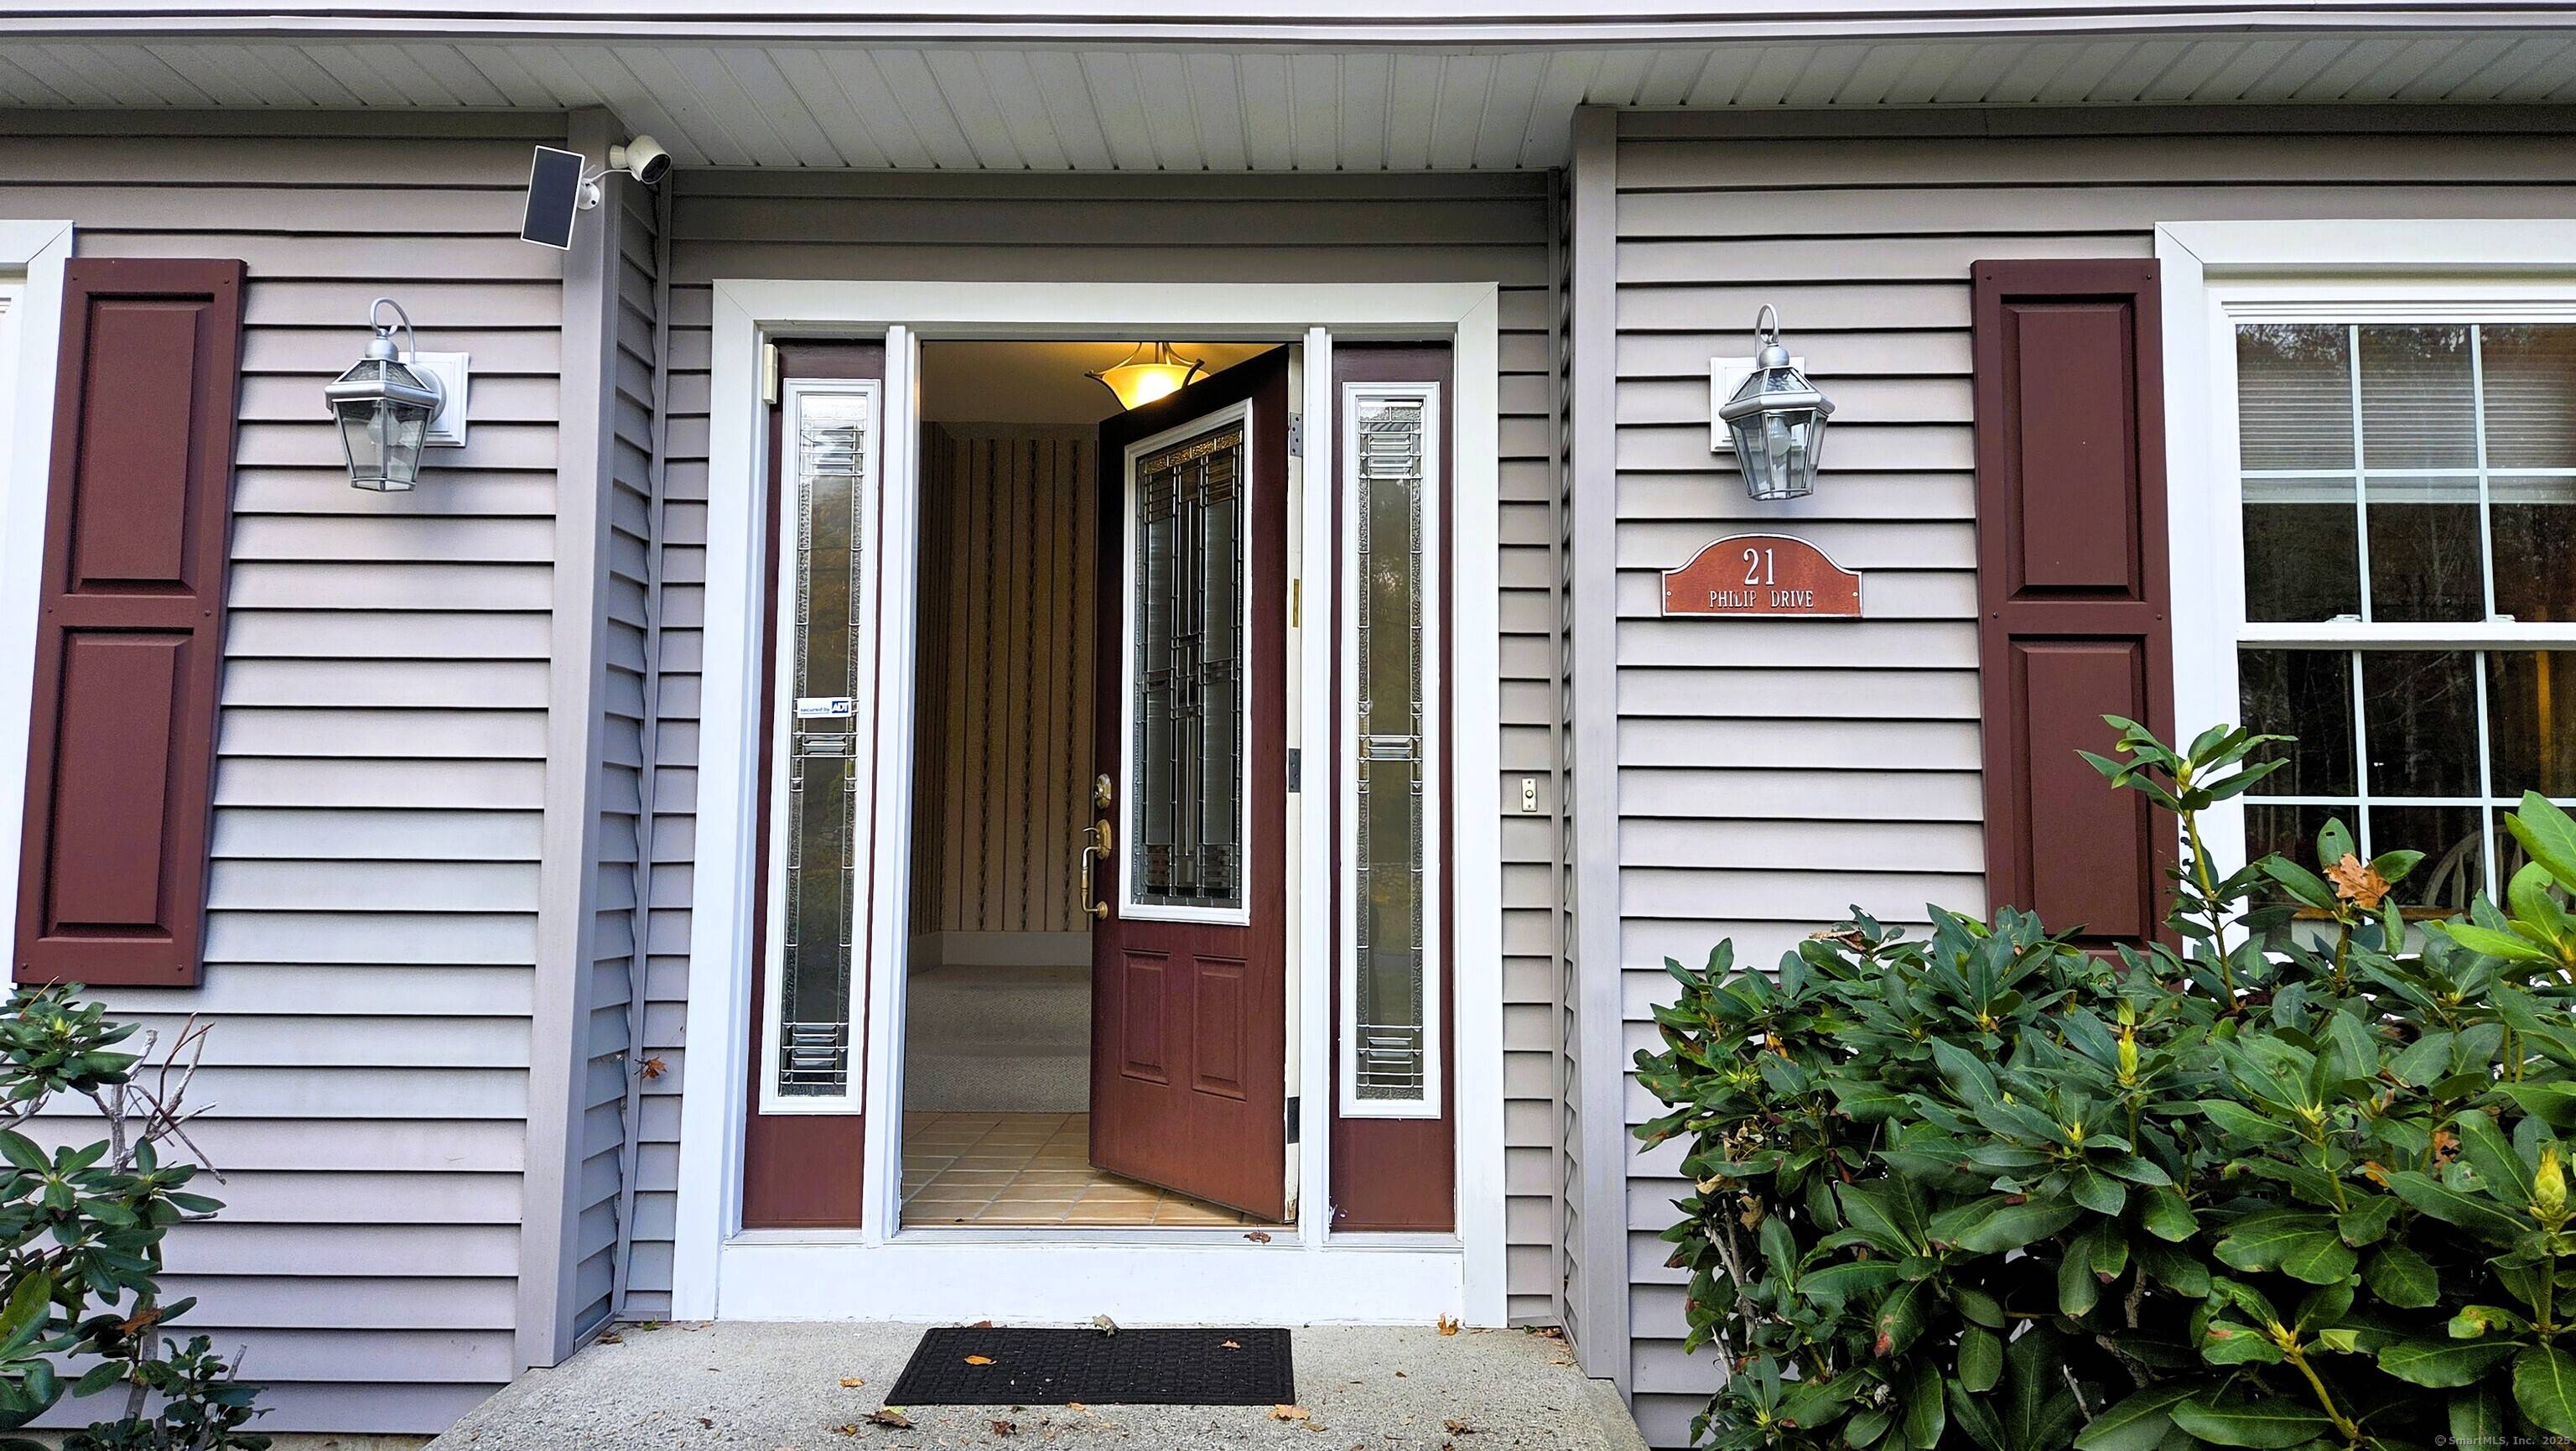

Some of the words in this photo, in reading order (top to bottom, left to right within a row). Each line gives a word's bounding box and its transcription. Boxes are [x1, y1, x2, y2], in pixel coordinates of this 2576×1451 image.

[1743, 548, 1775, 585] 21
[1709, 590, 1758, 608] PHILIP
[1770, 590, 1815, 608] DRIVE
[832, 702, 849, 712] ADT
